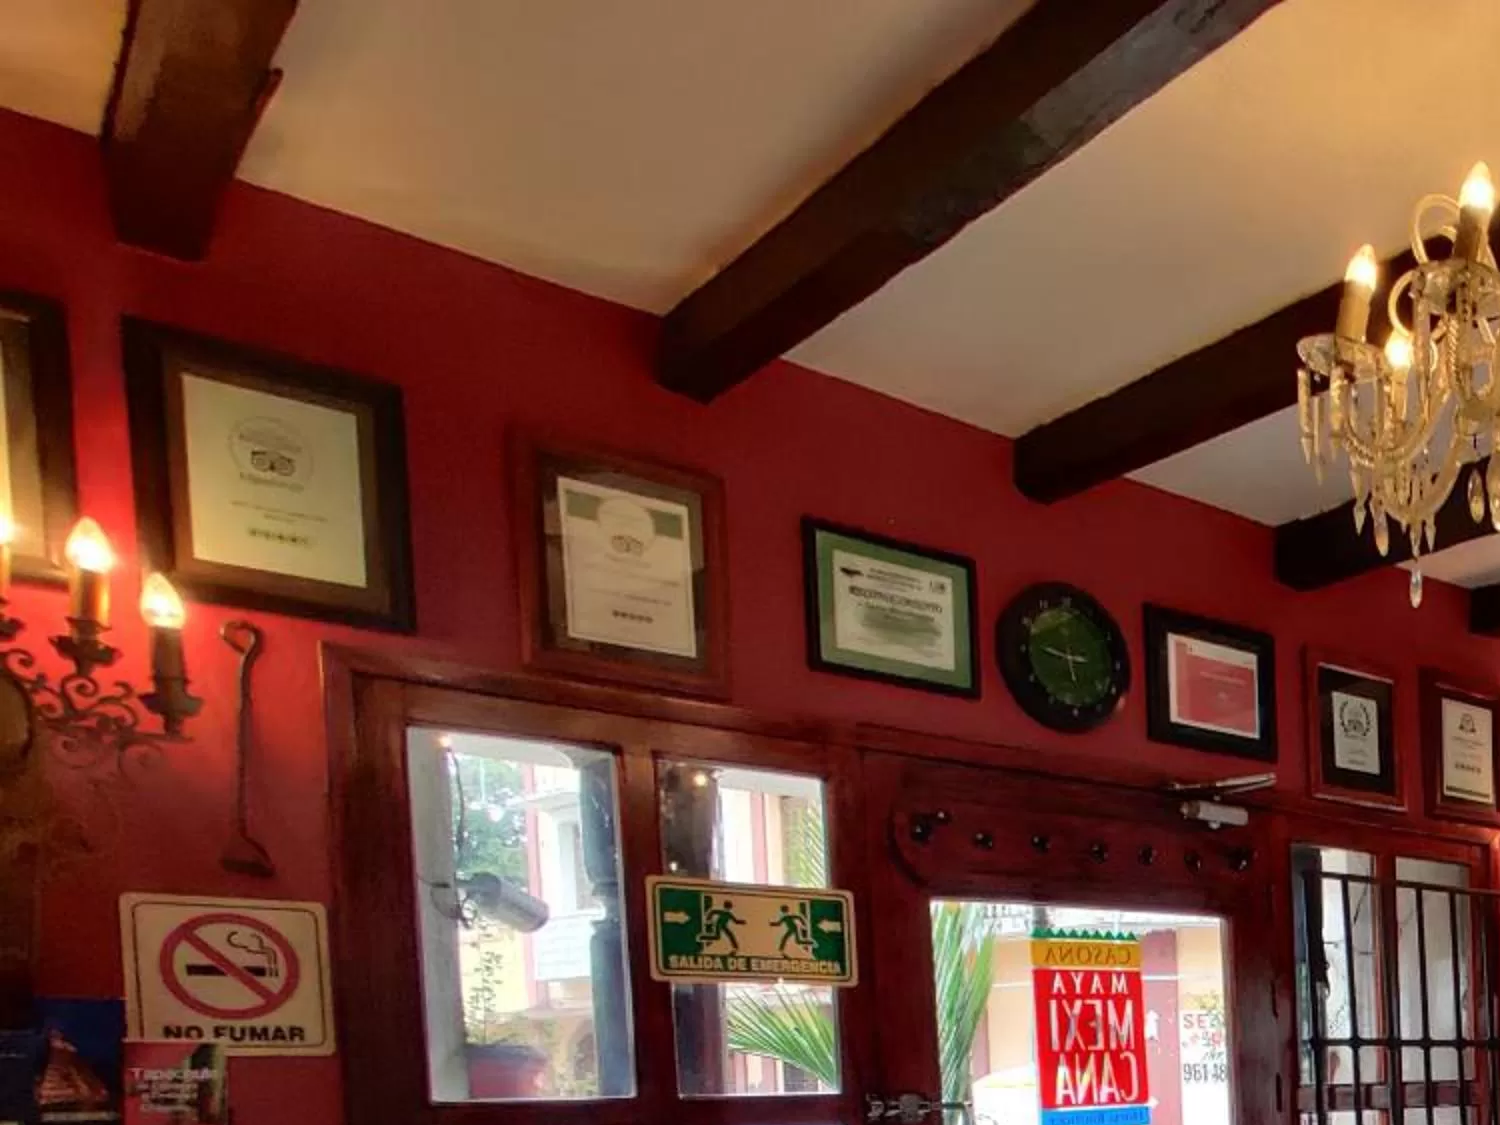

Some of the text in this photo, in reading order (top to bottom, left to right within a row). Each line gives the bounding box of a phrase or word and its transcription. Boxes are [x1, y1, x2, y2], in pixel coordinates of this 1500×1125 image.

[667, 955, 842, 975] SALIDA DE EMERGENCIA
[163, 1025, 306, 1043] NO FUMAR
